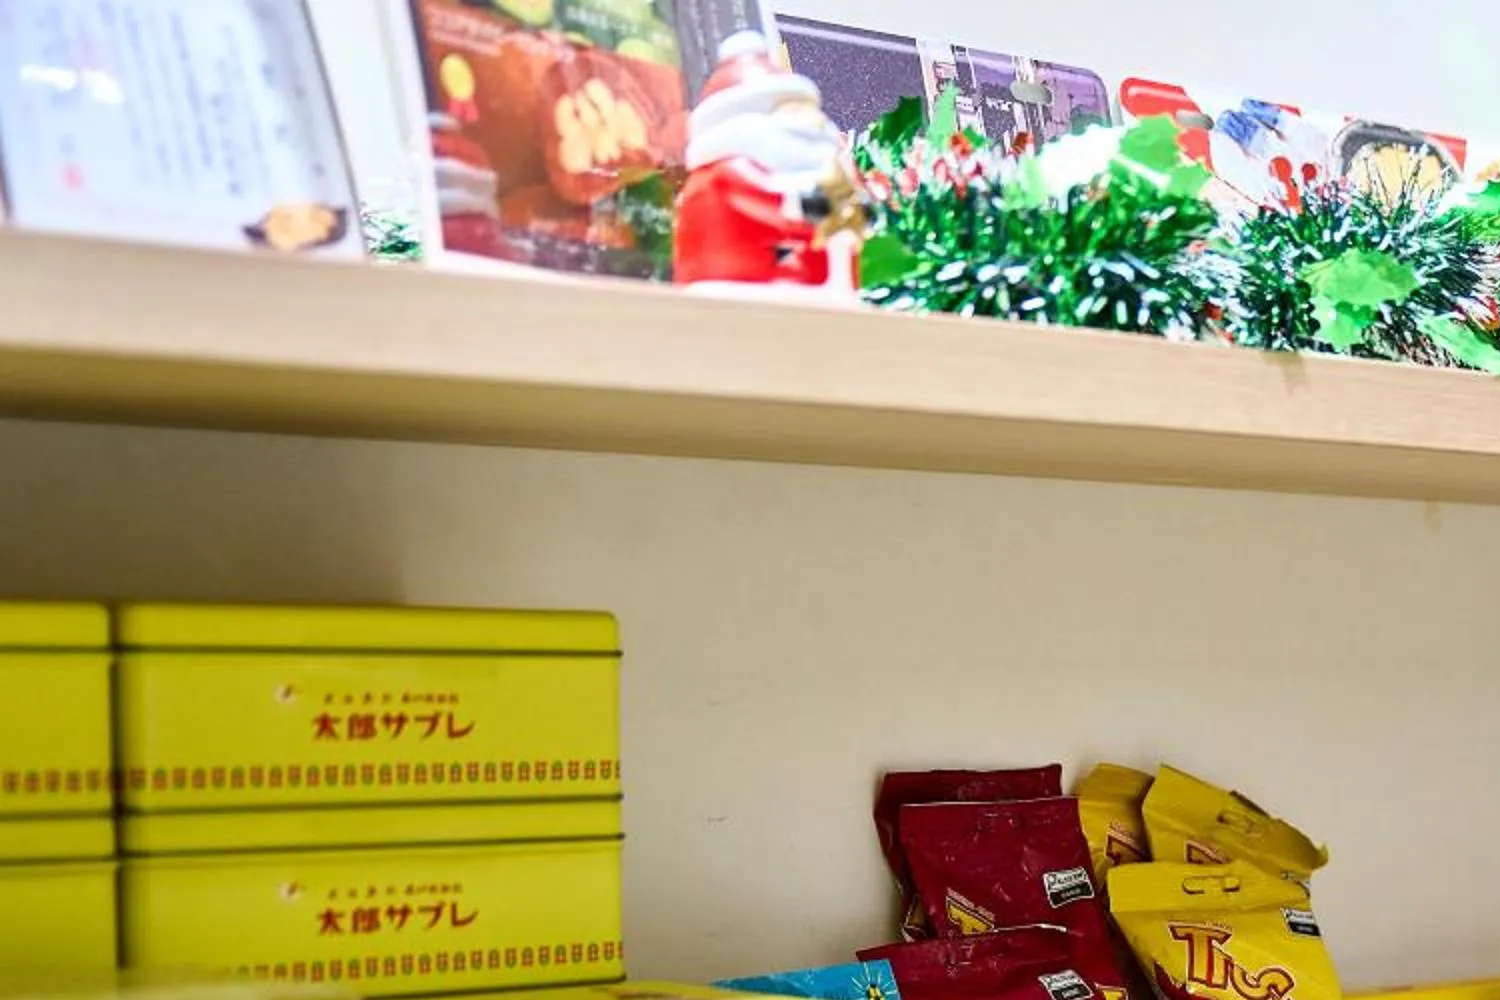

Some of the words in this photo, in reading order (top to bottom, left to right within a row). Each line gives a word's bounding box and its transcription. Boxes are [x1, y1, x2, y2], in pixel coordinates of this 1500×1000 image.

[311, 711, 477, 741] 太郎サブレ
[317, 903, 479, 935] 太郎サブレ
